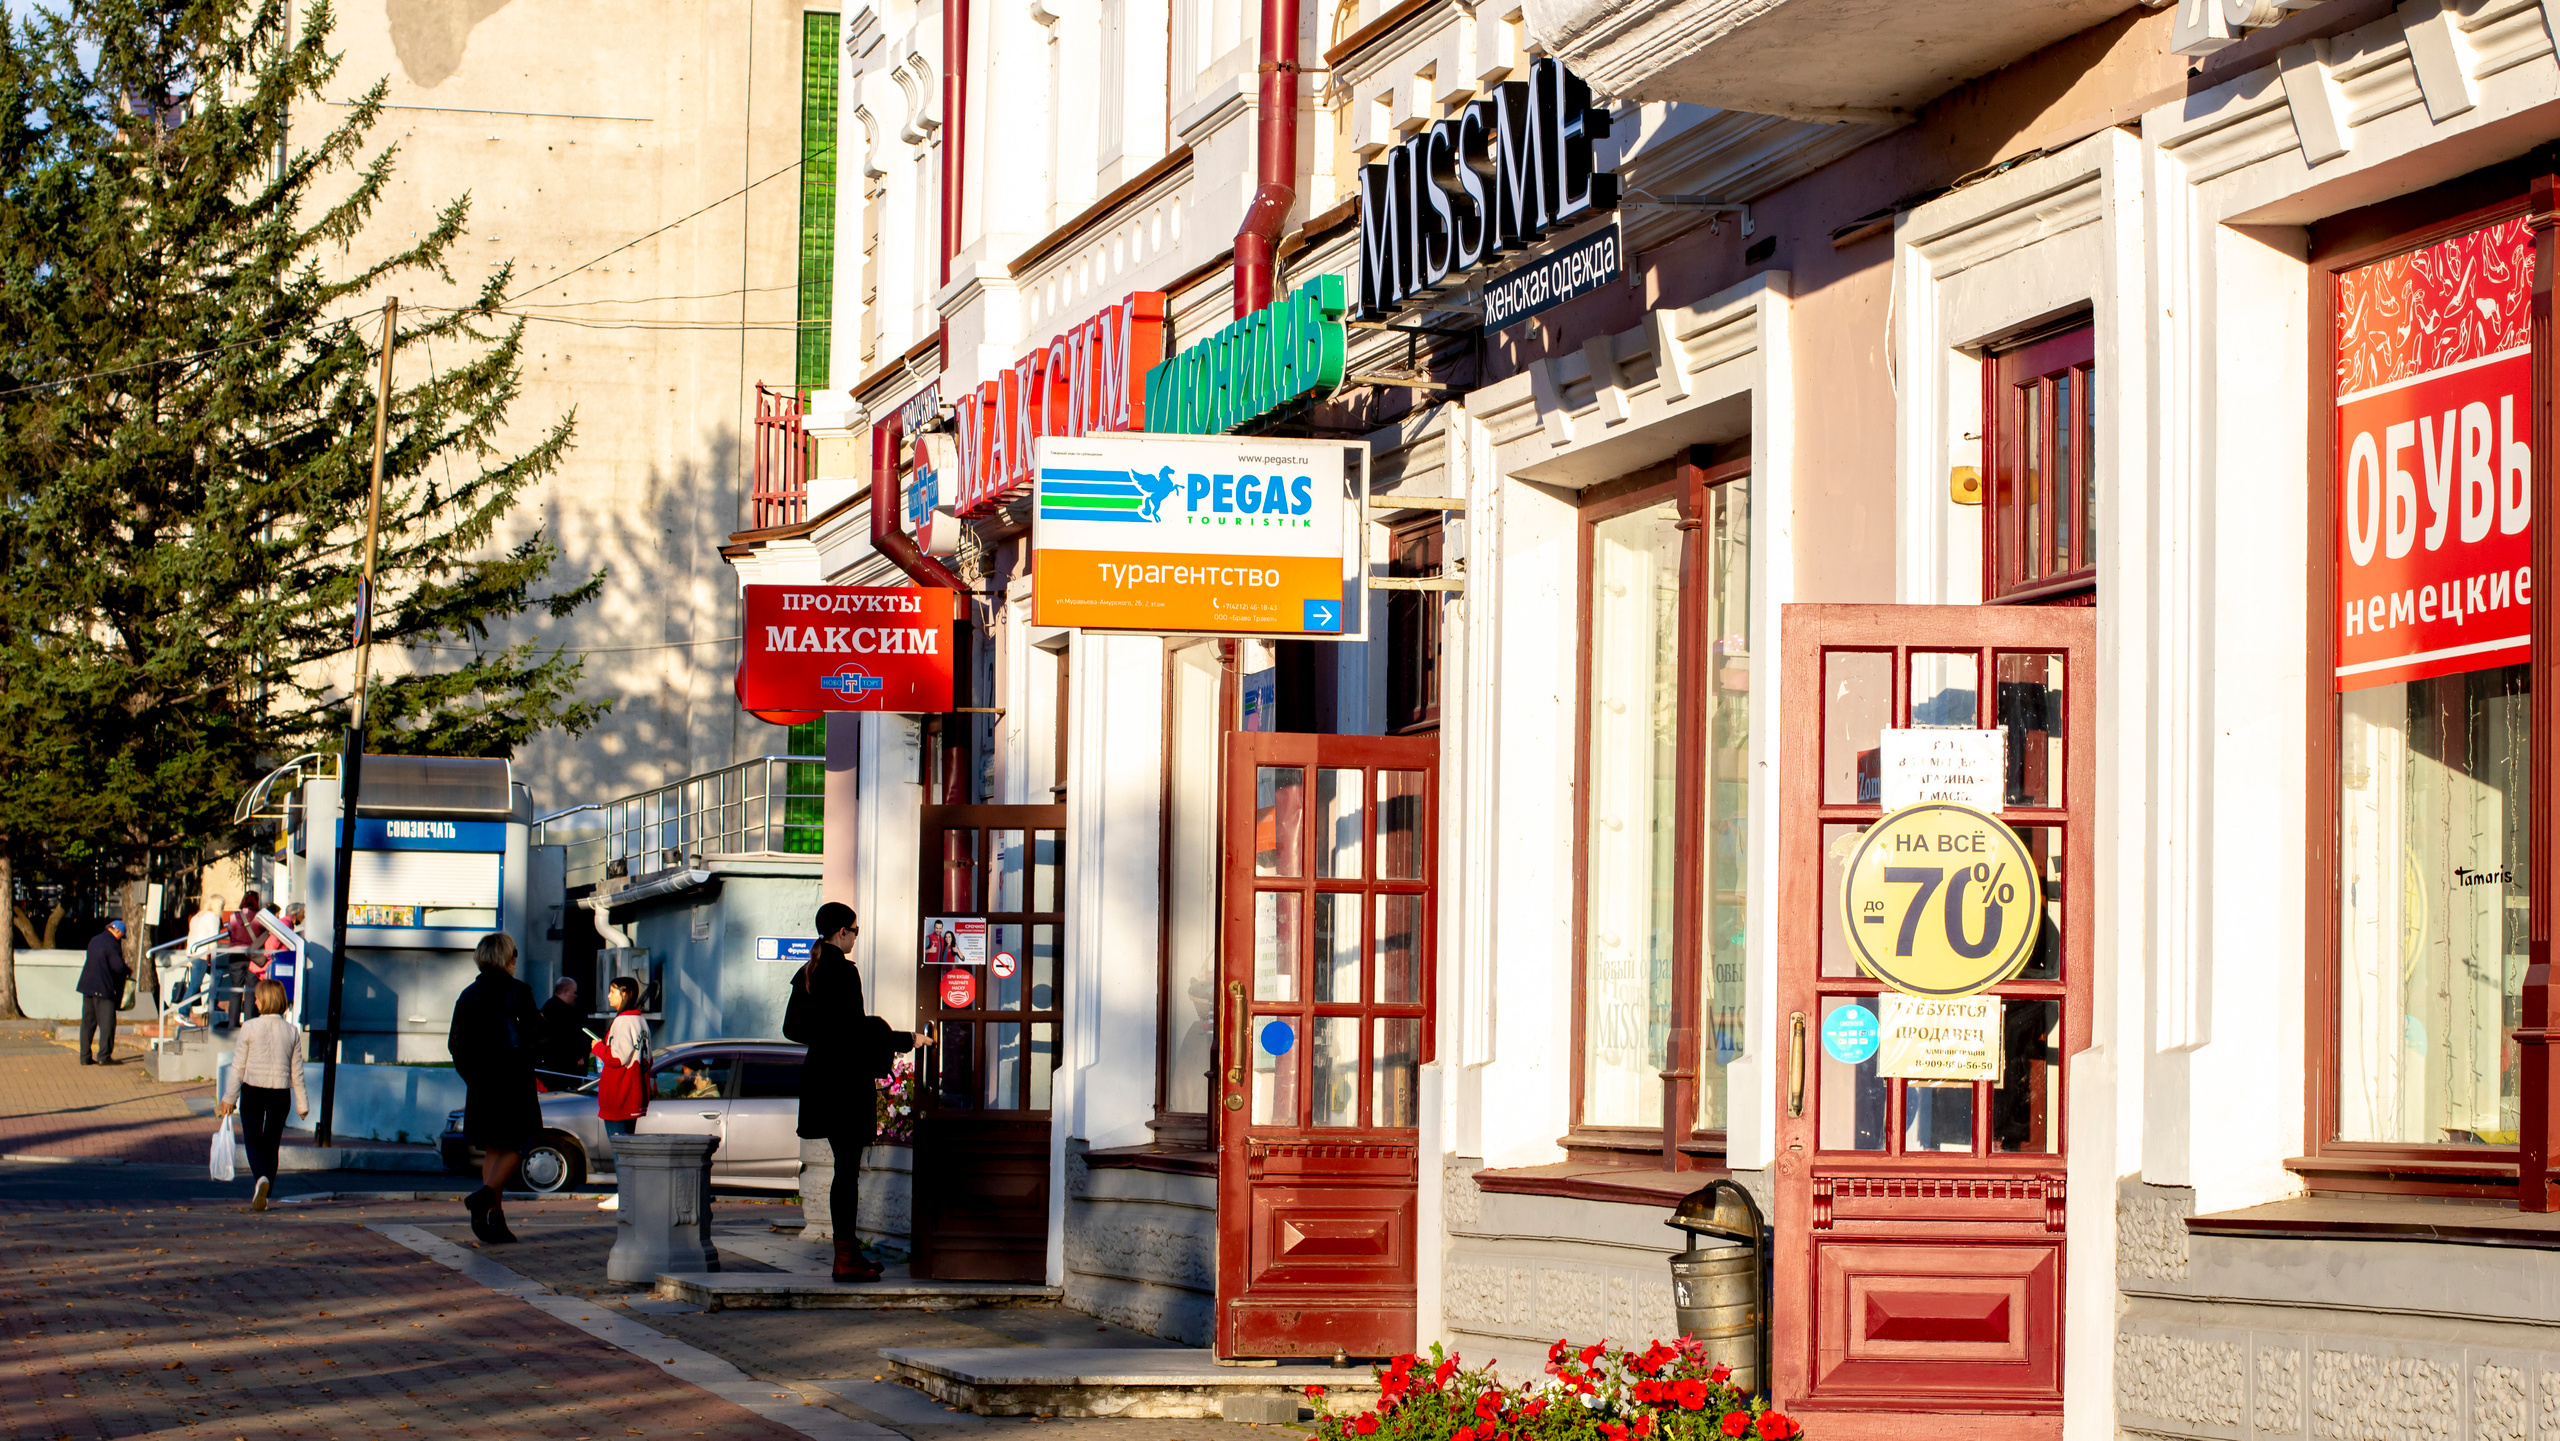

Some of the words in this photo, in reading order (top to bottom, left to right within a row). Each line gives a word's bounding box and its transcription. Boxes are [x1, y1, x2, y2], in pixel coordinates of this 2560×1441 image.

[1485, 265, 1549, 327] женская
[1552, 236, 1615, 302] одежда
[955, 296, 1140, 514] МАКСИМ
[1238, 454, 1309, 466] www.pegast.ru
[2347, 394, 2531, 566] ОБУВЬ
[1187, 473, 1312, 516] PEGAS
[1187, 516, 1312, 528] TOURISTIK
[1098, 563, 1280, 589] турагентство
[782, 593, 922, 614] ПРОДУКТЫ
[2346, 566, 2531, 637] немецкие
[765, 626, 939, 655] МАКСИМ
[387, 821, 456, 838] СОЮЗПЕЧАТЬ
[1896, 834, 1929, 852] НА
[1938, 831, 1986, 852] ВСЁ
[2454, 864, 2512, 887] Tamaris
[1895, 1026, 1985, 1044] ПРОДАВЕЦ
